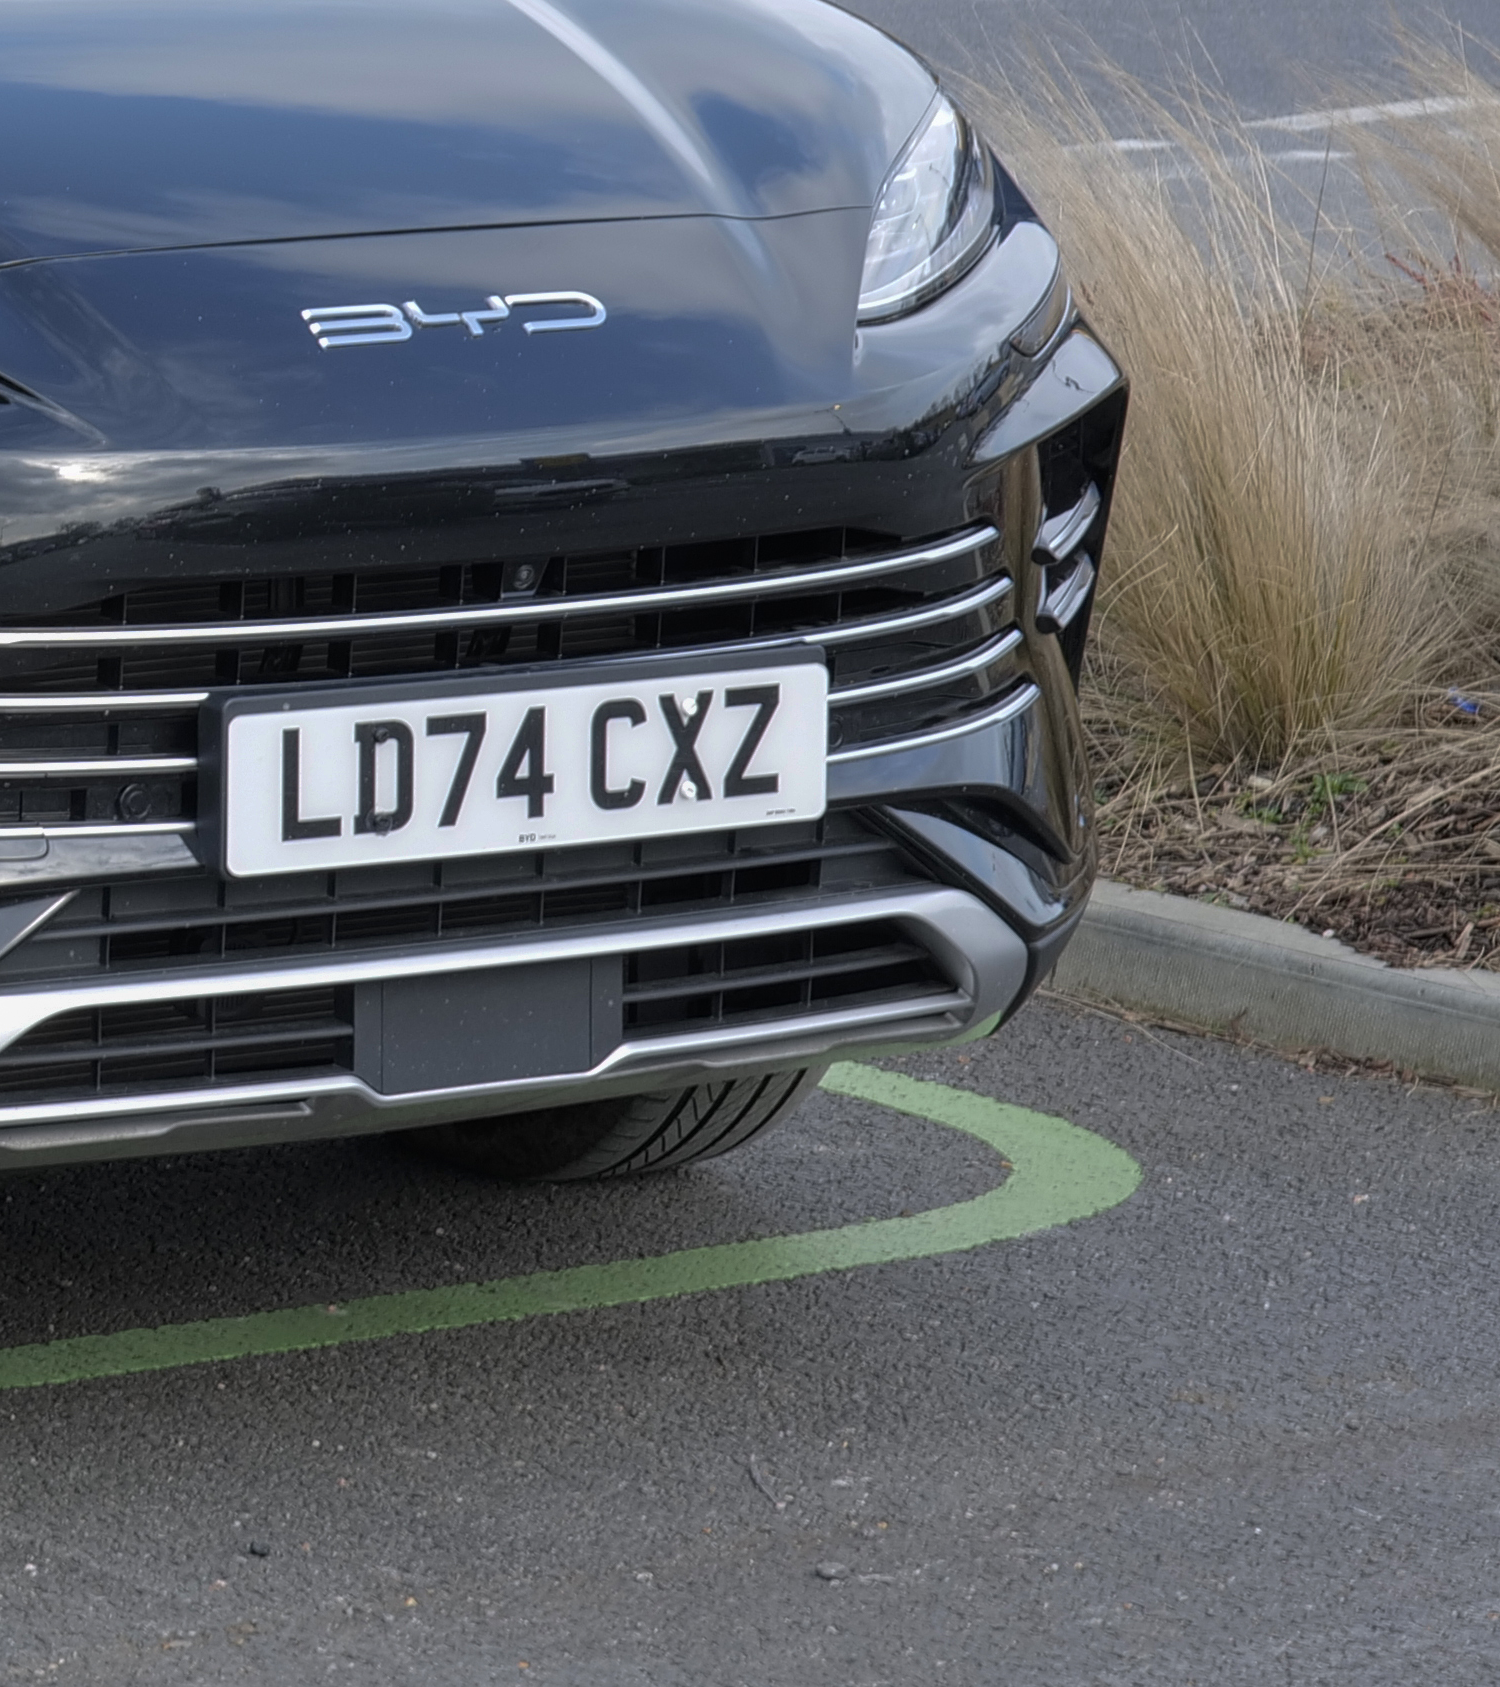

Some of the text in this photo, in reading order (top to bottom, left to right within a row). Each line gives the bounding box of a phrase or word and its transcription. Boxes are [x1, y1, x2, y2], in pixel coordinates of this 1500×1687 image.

[301, 291, 607, 350] BYD
[279, 682, 781, 844] LD74 CXZ
[519, 833, 537, 843] BYD
